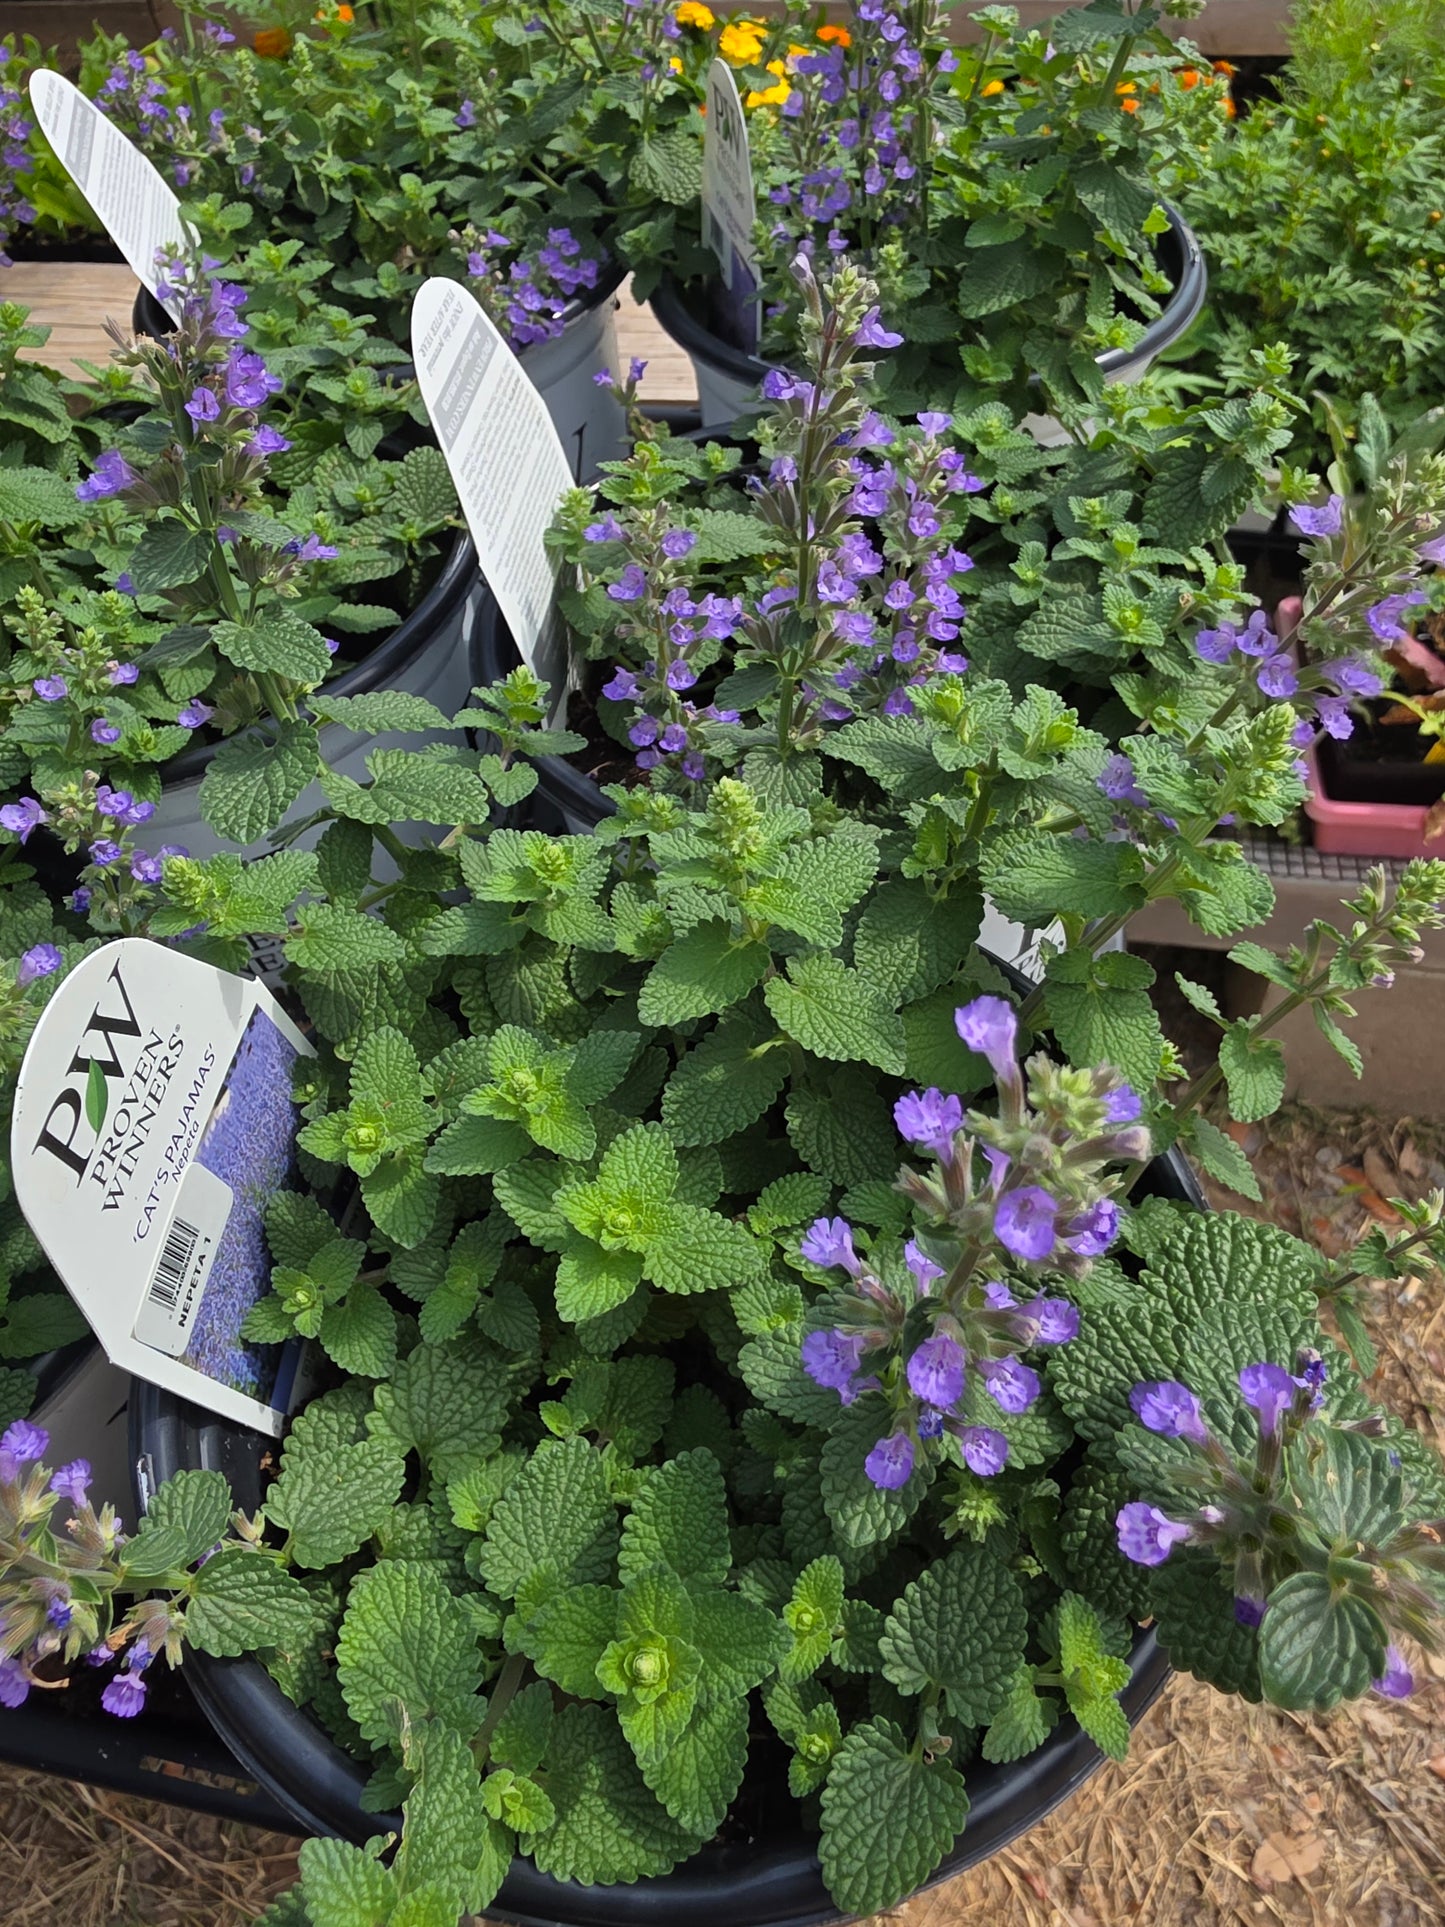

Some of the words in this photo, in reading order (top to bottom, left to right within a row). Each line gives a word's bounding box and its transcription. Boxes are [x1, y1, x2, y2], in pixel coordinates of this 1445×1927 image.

[31, 957, 142, 1188] PW
[90, 1027, 164, 1189] PROVEN
[171, 1119, 200, 1184] Nepeta
[178, 1254, 206, 1328] NEPETA
[204, 1236, 211, 1244] 1
